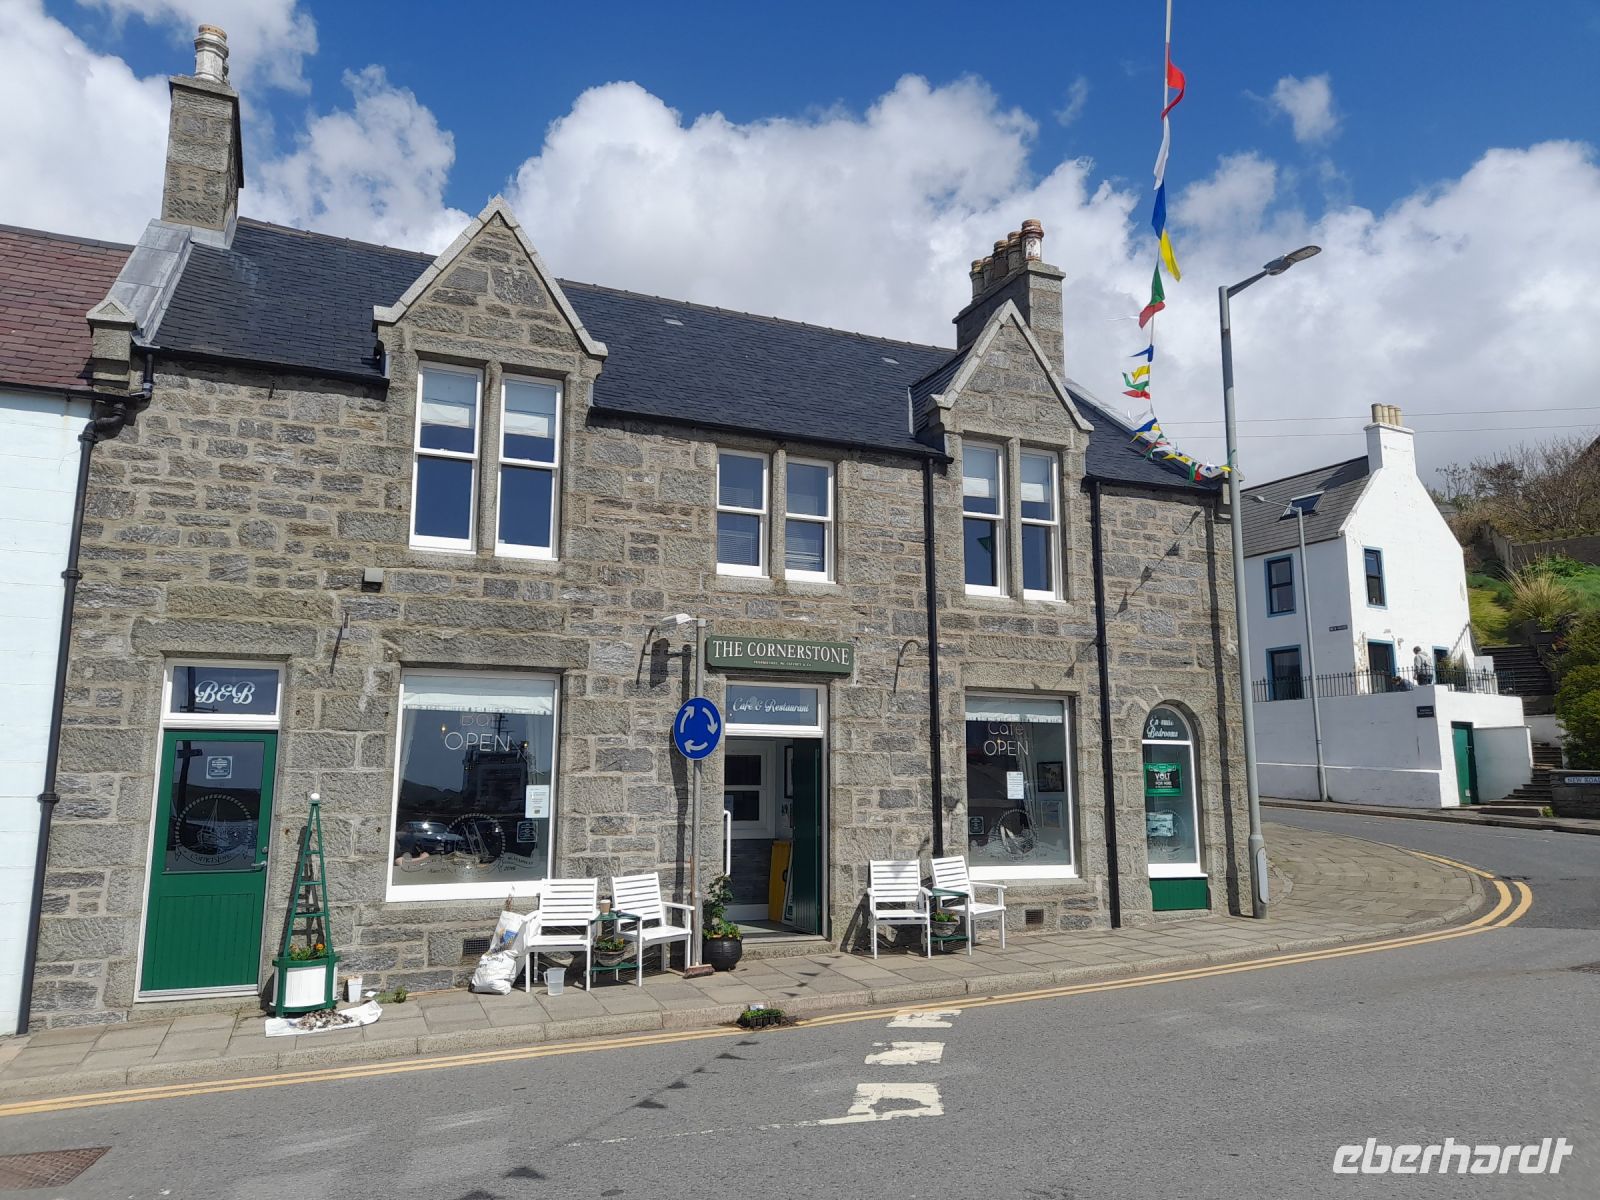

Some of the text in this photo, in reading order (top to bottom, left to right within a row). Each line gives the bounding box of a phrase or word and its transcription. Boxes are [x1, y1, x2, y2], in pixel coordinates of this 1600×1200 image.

[713, 641, 850, 665] THE CORNERSTONE
[194, 680, 256, 704] B&B
[764, 698, 810, 713] Restaurant
[444, 732, 511, 752] OPEN
[984, 740, 1029, 756] OPEN
